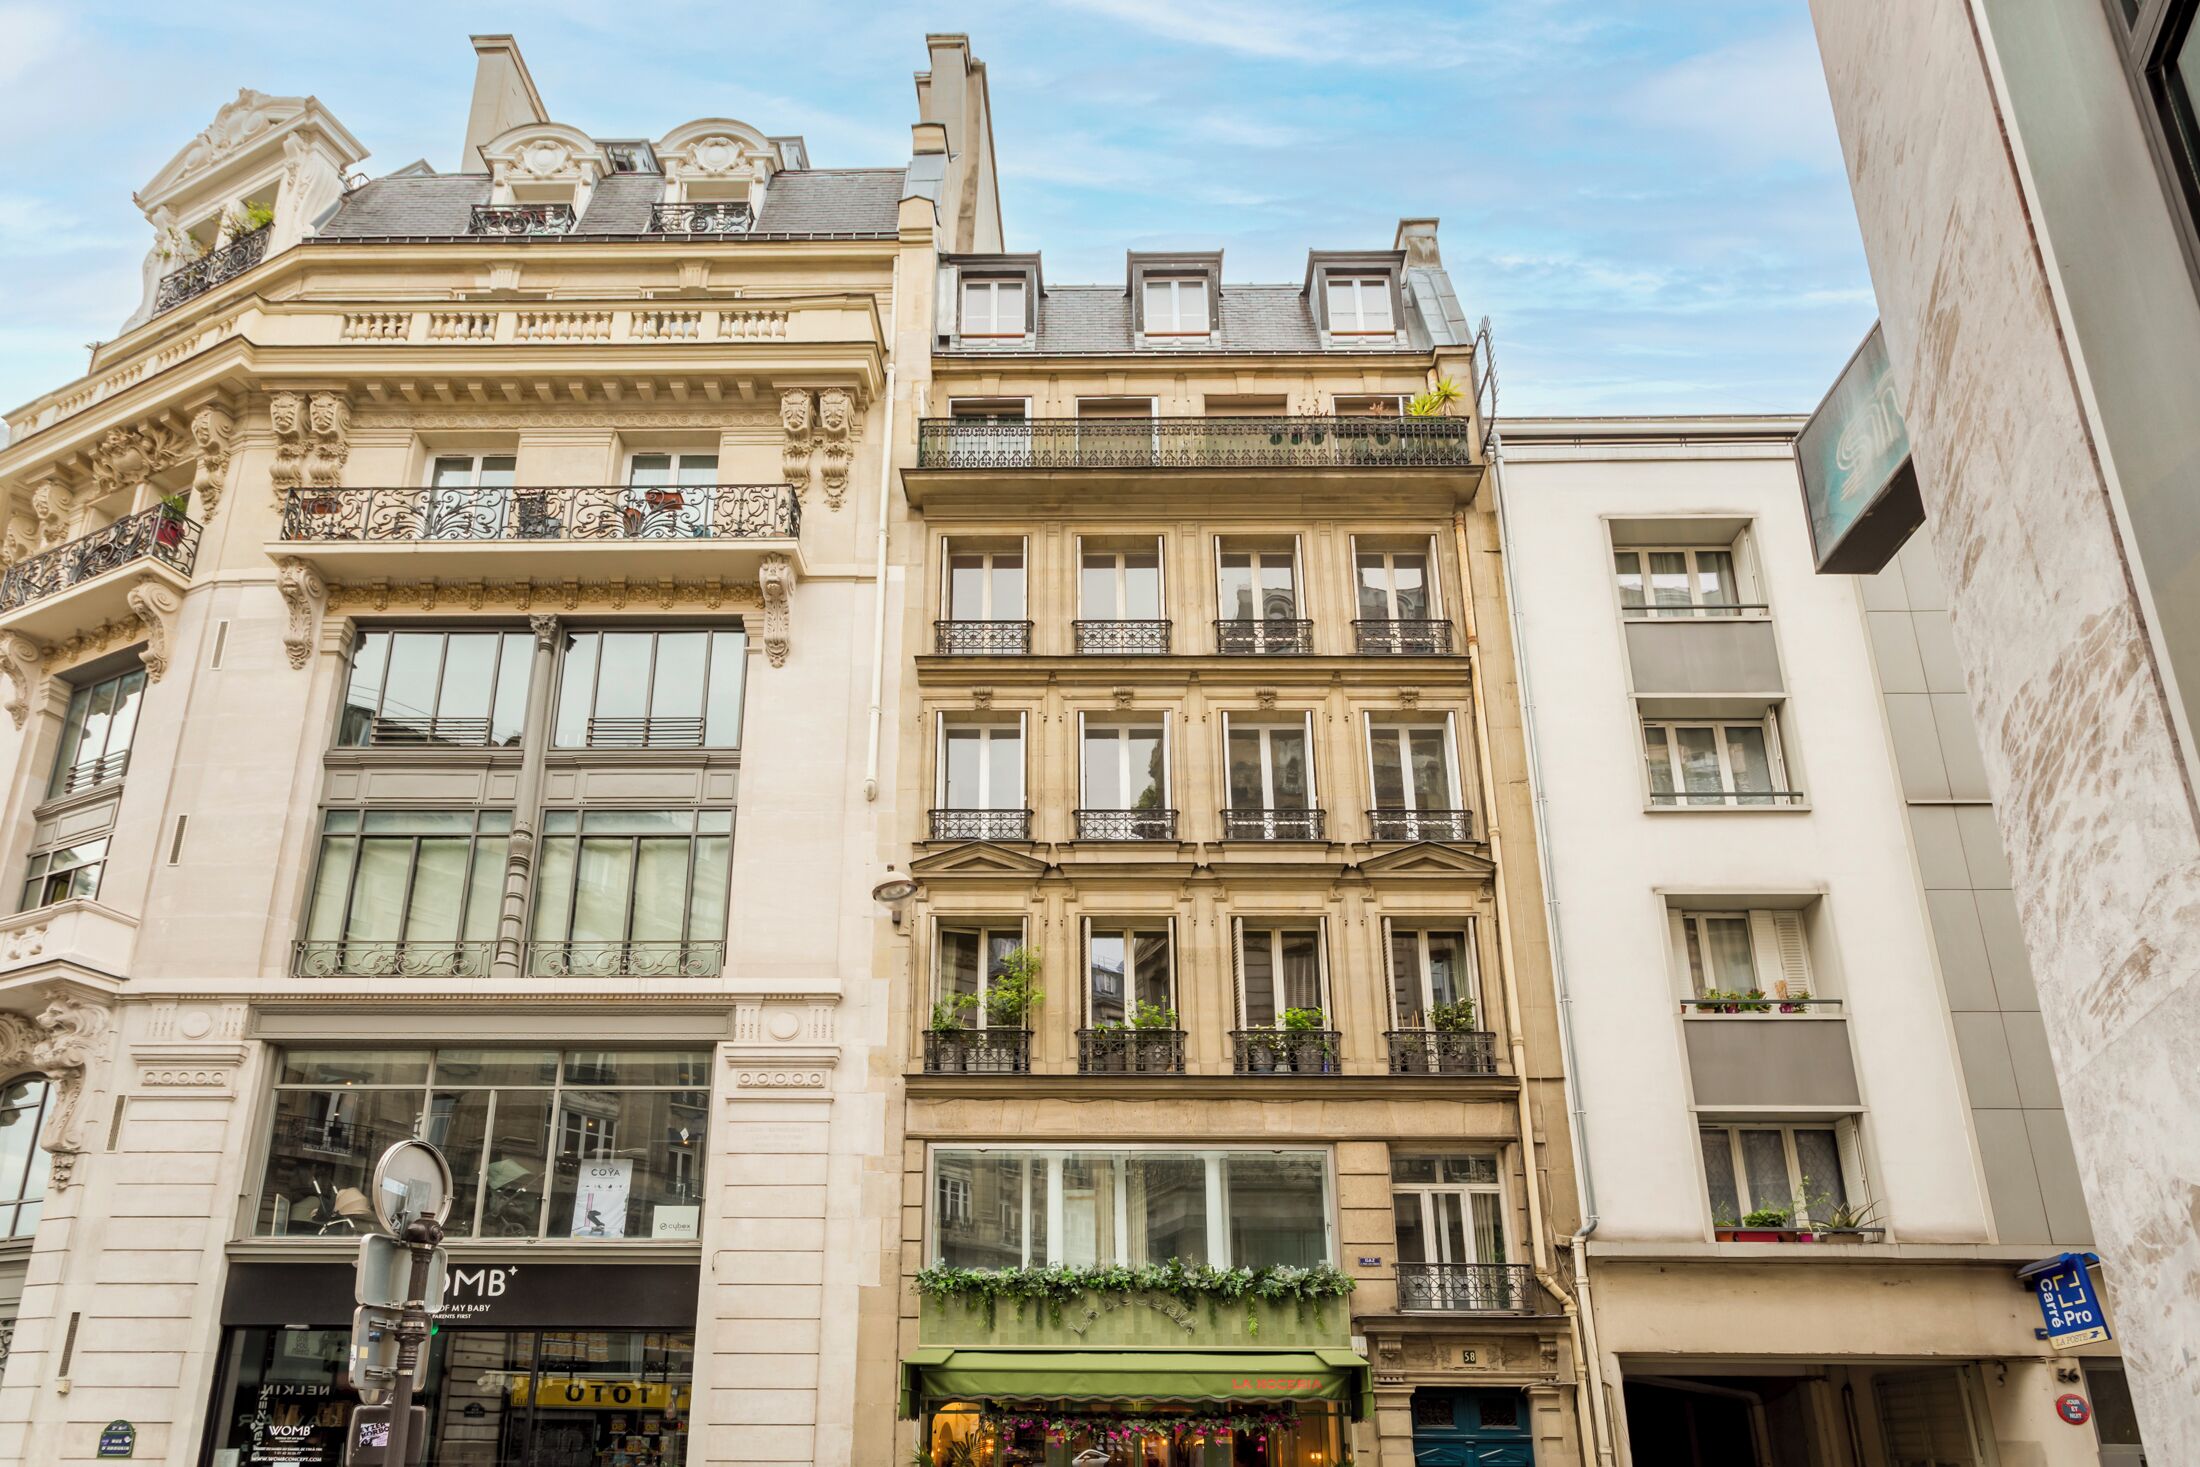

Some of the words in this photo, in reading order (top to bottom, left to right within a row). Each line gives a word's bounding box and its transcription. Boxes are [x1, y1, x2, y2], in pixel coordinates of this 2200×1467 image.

[443, 1269, 506, 1297] MB
[451, 1304, 466, 1312] MY
[467, 1304, 491, 1312] BABY
[2040, 1278, 2065, 1328] Carré
[2063, 1310, 2093, 1327] Pro
[2055, 1337, 2066, 1346] LA
[2065, 1332, 2089, 1344] POSTE
[1464, 1351, 1476, 1362] 58
[2057, 1368, 2080, 1384] 56
[1232, 1378, 1252, 1390] LA
